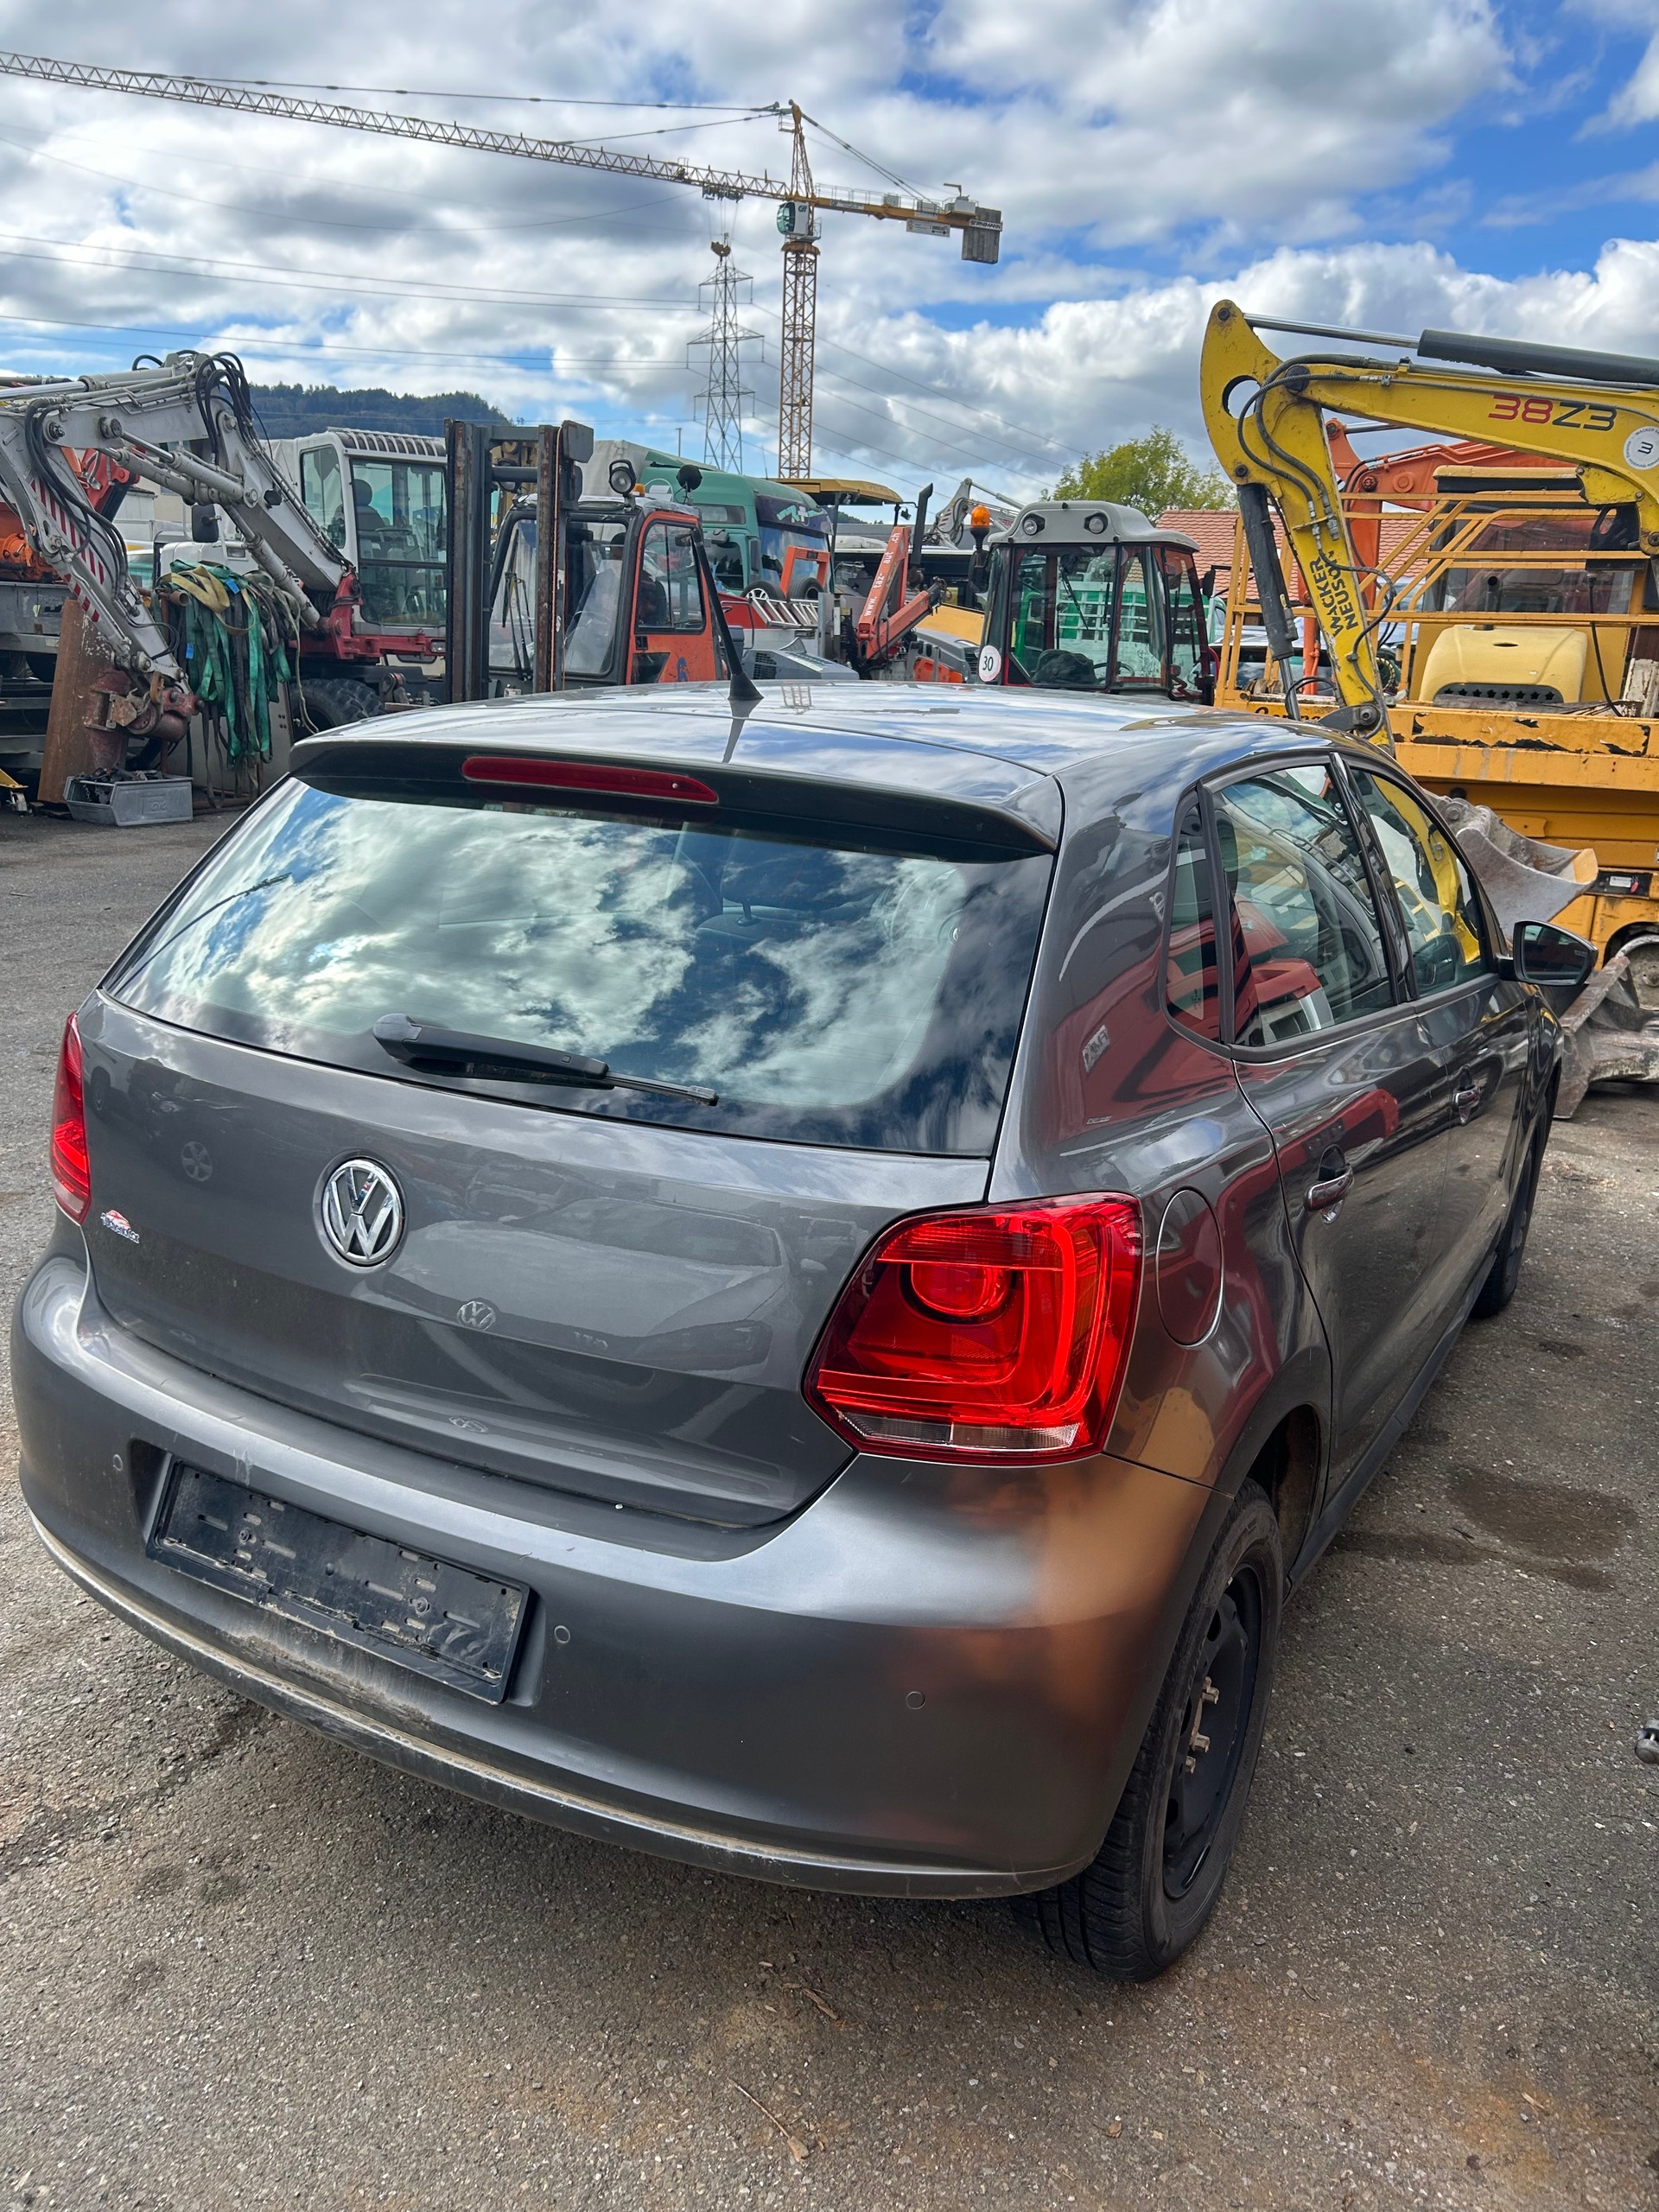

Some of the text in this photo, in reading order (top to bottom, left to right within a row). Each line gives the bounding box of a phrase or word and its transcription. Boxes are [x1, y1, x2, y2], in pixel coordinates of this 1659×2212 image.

[1488, 394, 1618, 431] 38Z3
[1309, 556, 1344, 638] WACKER
[982, 655, 994, 671] 30
[322, 1160, 401, 1266] VW
